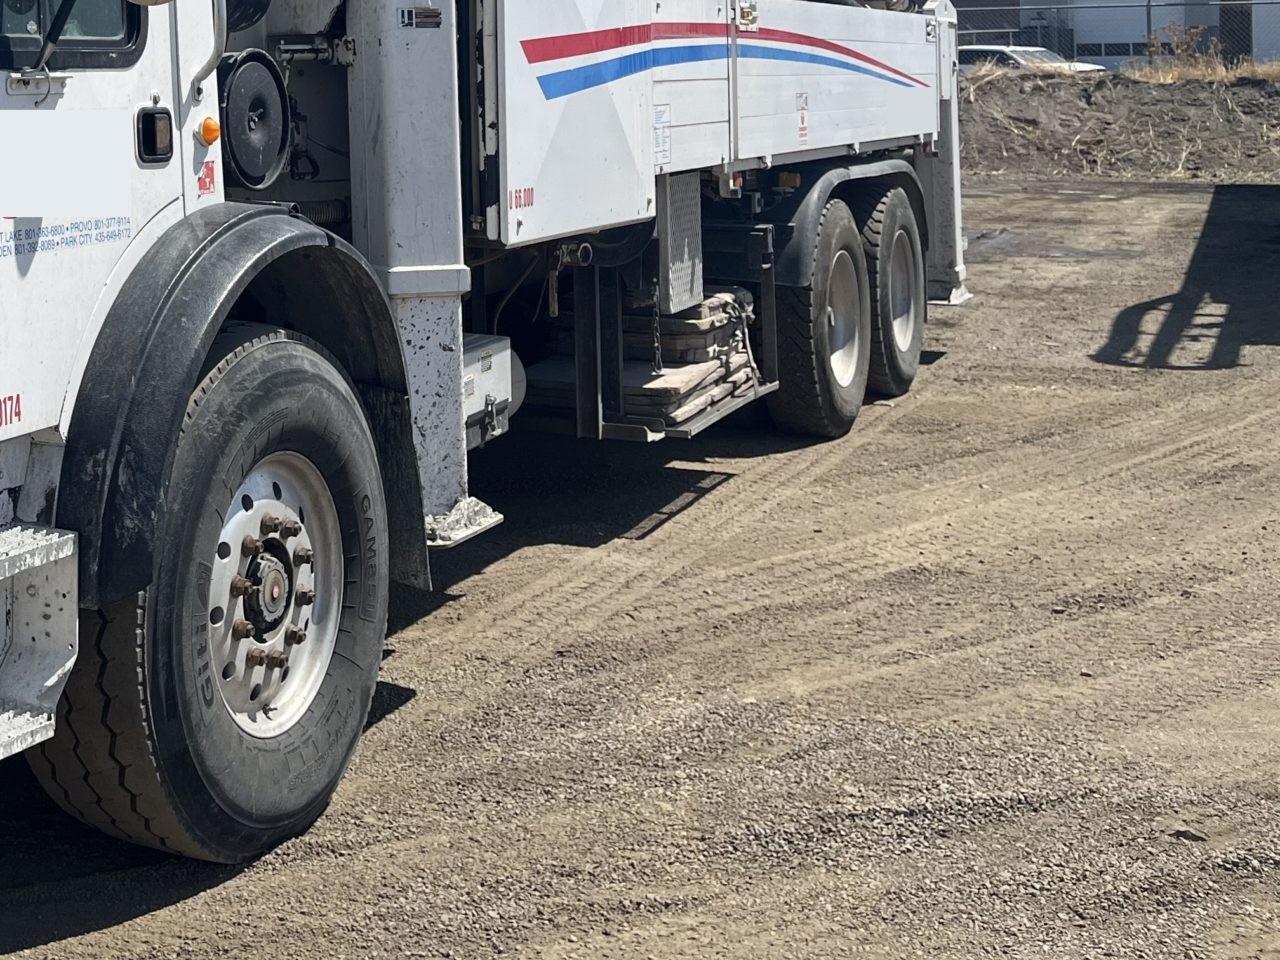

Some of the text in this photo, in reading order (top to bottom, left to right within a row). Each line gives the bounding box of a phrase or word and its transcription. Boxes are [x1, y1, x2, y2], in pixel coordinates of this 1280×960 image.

[5, 230, 22, 243] LAKE
[70, 220, 92, 234] PROVO
[60, 236, 77, 248] PARK
[80, 233, 93, 245] CITY
